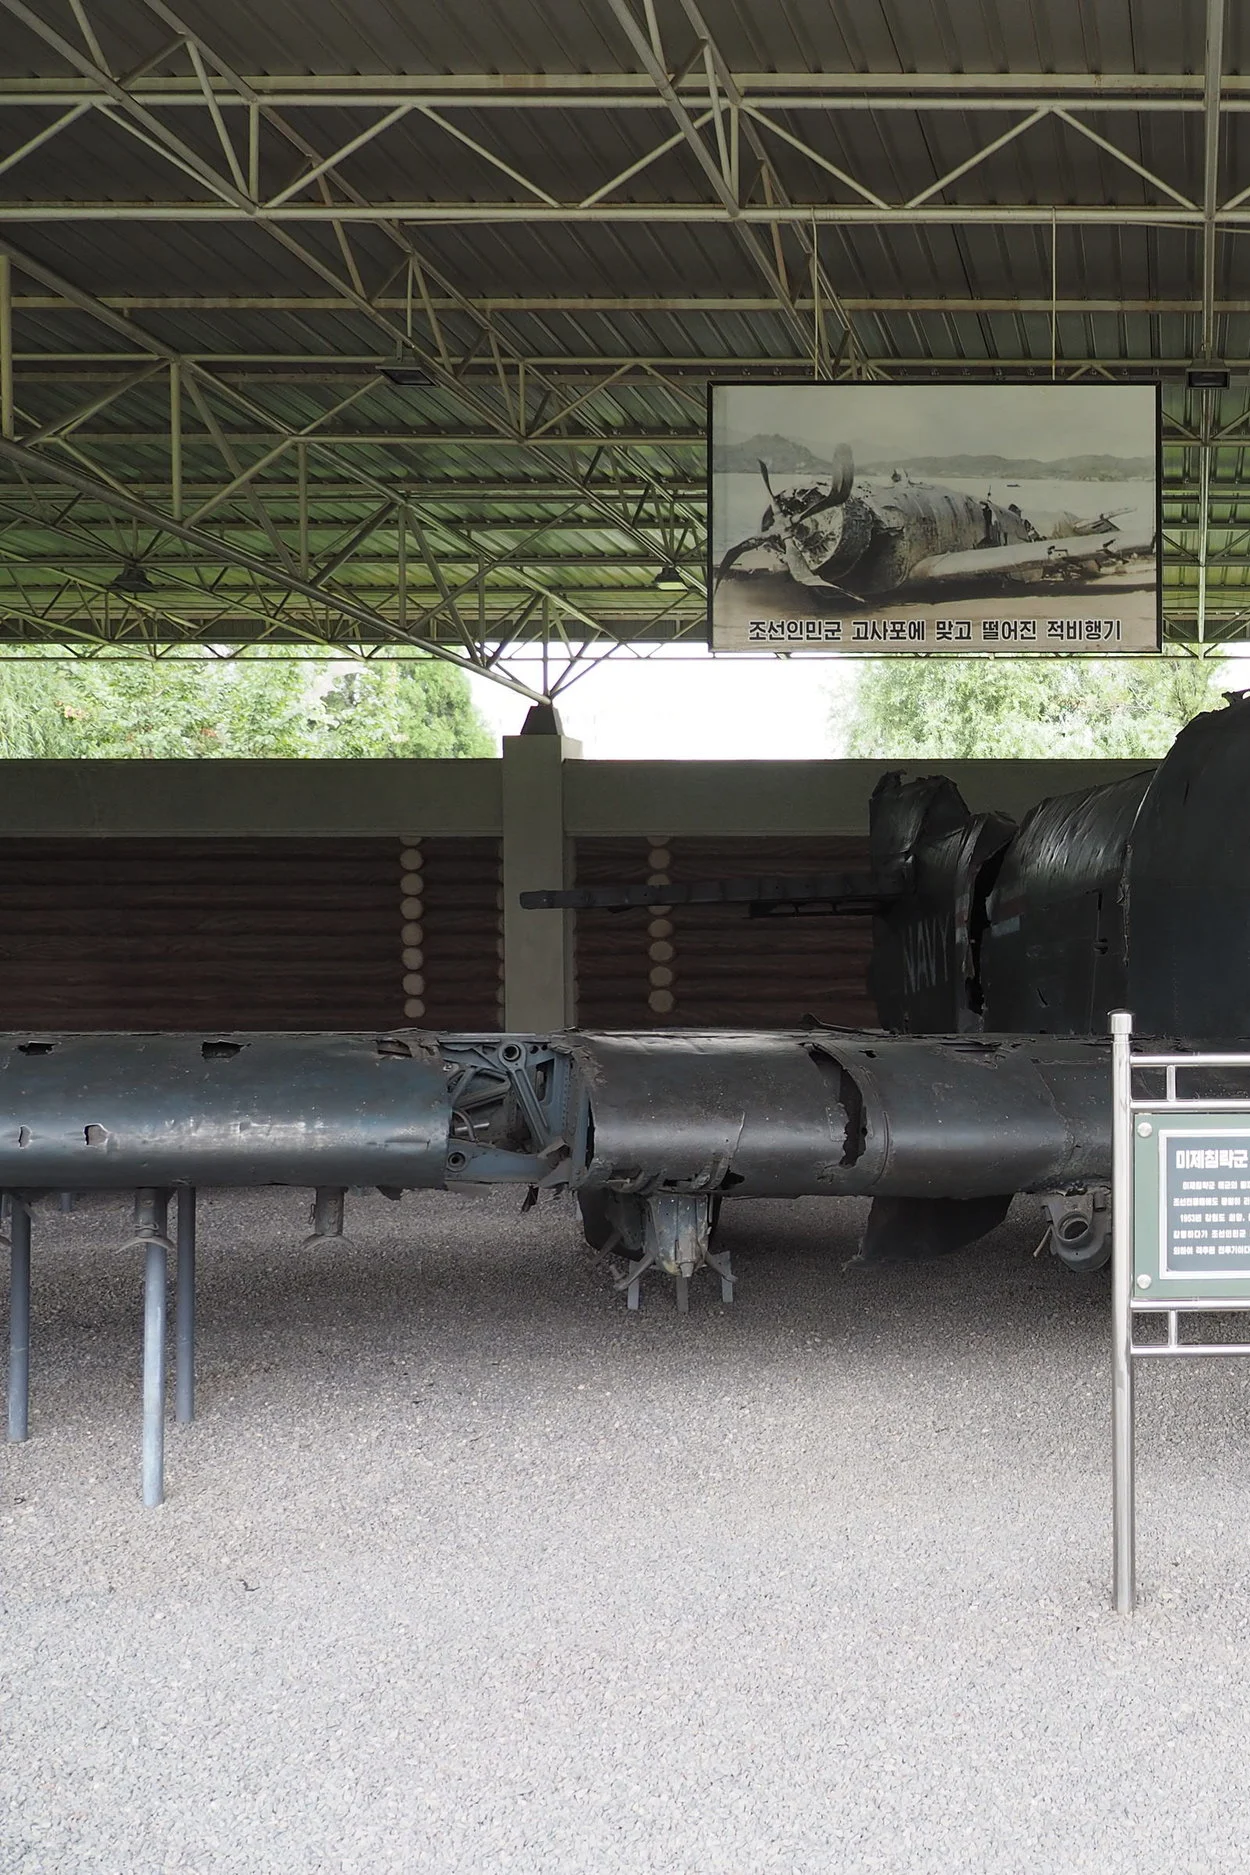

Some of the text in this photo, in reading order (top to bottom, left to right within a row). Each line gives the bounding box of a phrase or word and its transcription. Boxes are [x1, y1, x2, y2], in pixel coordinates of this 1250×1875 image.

[748, 619, 1122, 641] 조선인민군 고사포에 맞고 떨어진 적비행기
[901, 912, 950, 995] NAVY
[1176, 1149, 1248, 1169] 미제침략군
